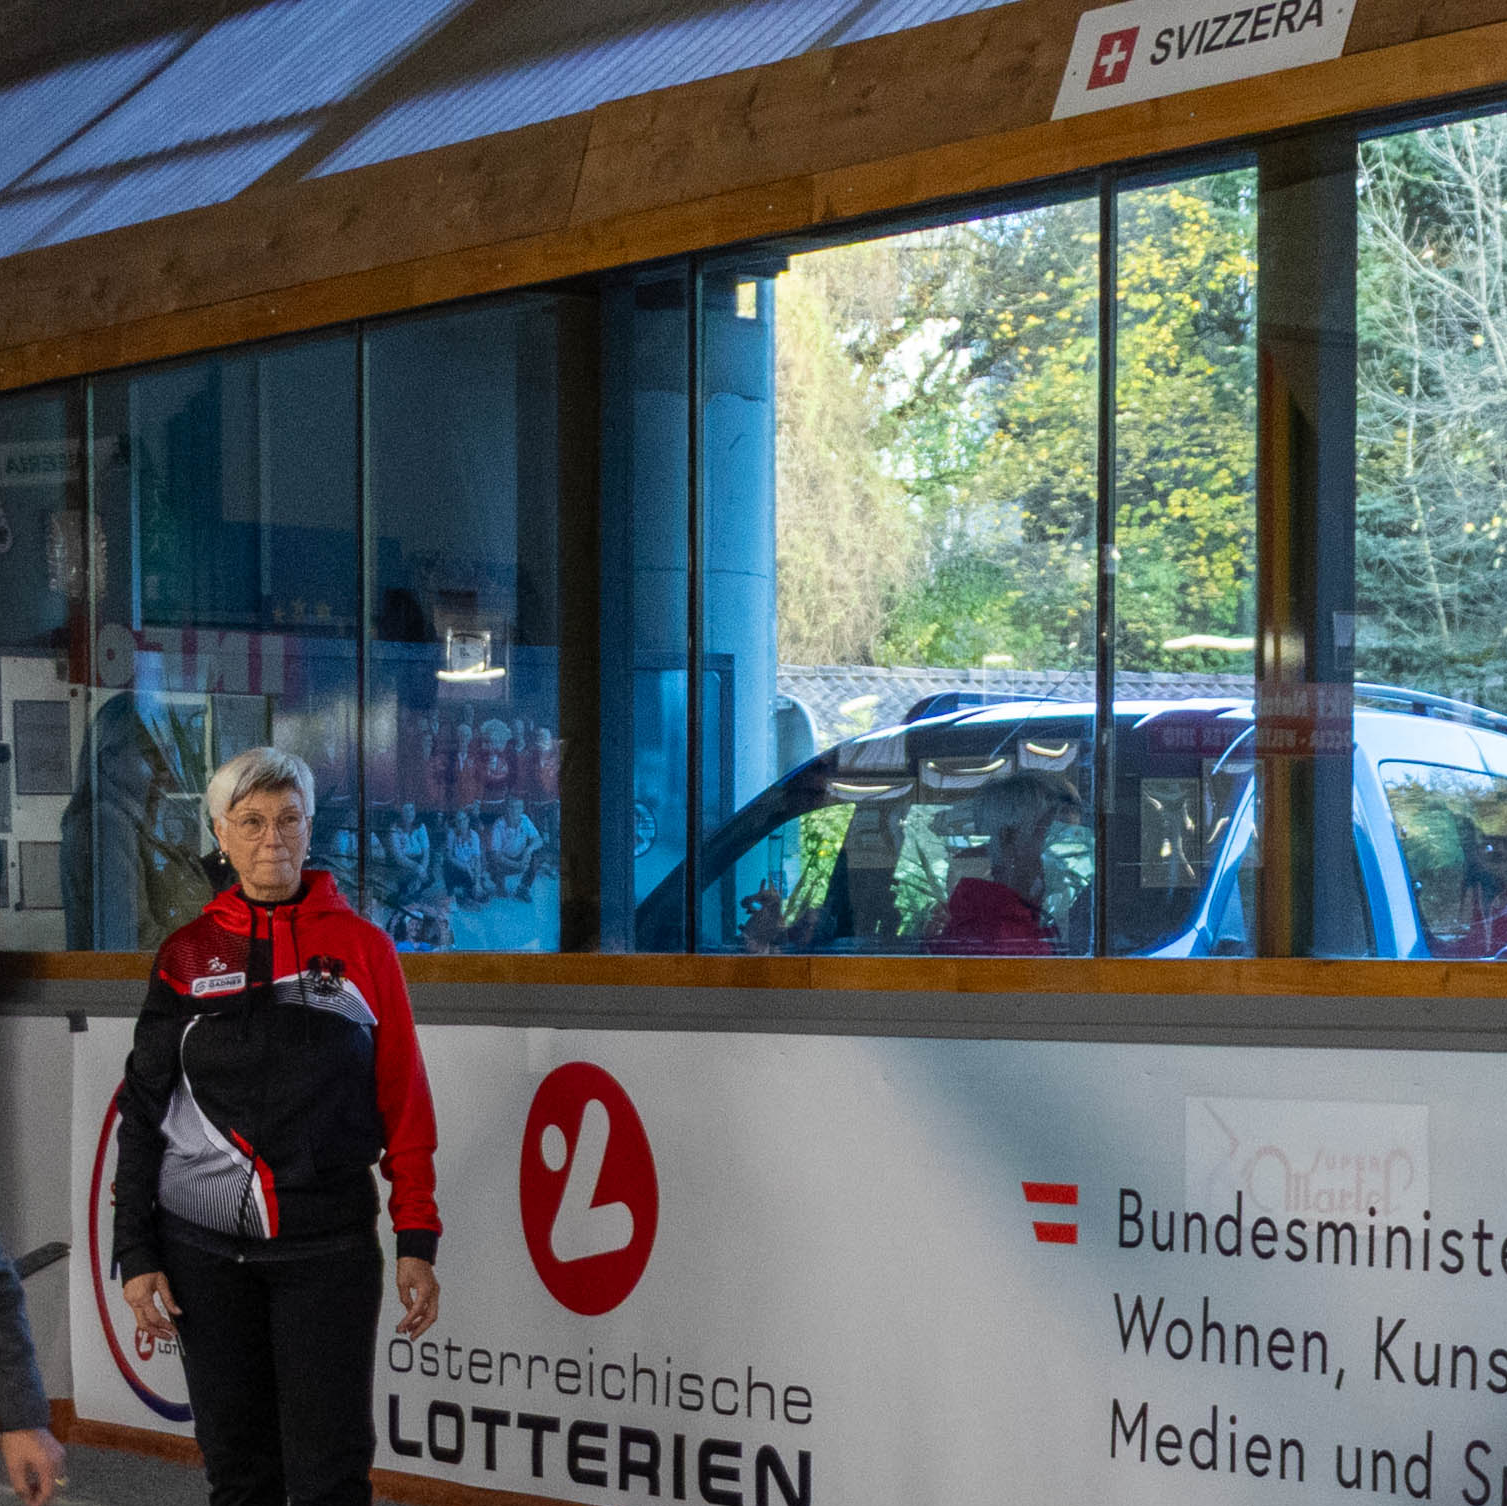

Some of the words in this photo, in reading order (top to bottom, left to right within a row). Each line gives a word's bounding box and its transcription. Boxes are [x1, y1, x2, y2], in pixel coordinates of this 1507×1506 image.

[1149, 0, 1324, 66] SVIZZERA
[1113, 1292, 1345, 1391] Wohnen,
[1110, 1398, 1305, 1483] Medien
[1335, 1429, 1434, 1501] und
